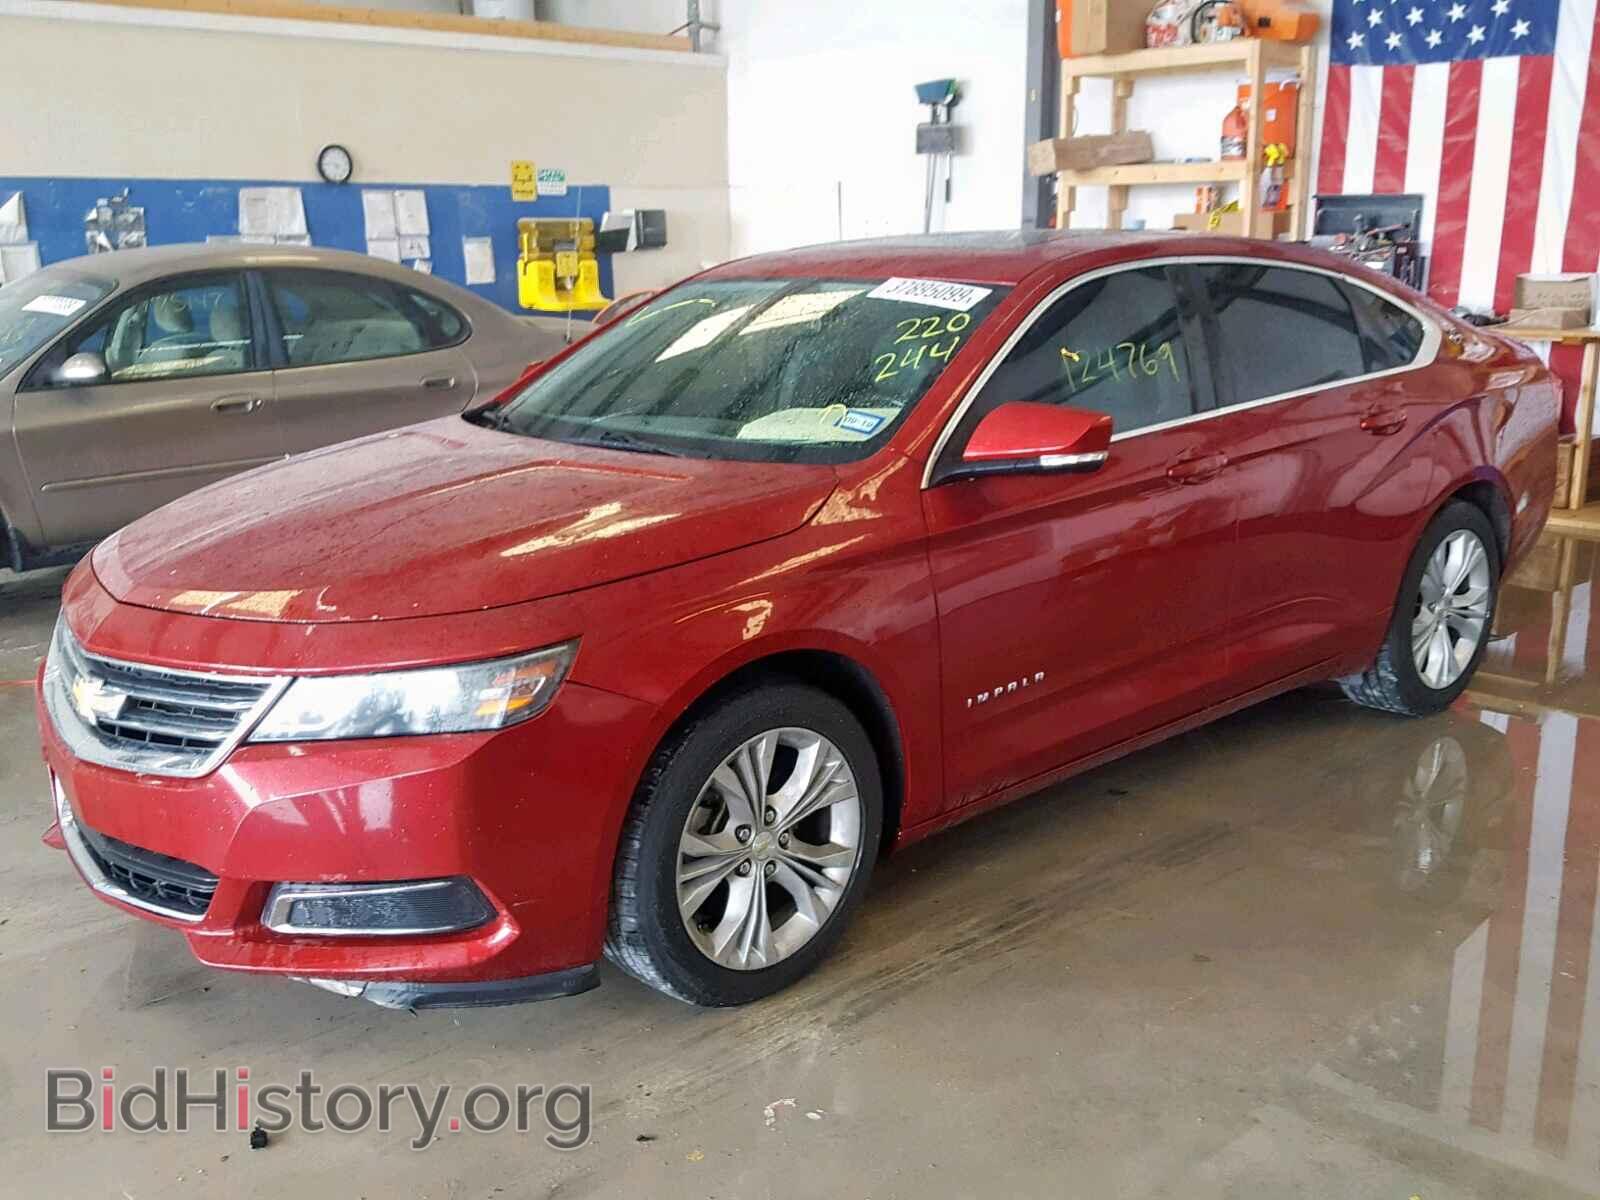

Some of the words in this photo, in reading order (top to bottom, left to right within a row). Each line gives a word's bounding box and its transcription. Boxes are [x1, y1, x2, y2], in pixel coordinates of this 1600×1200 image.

[893, 312, 971, 345] 220
[874, 335, 961, 383] 244
[966, 671, 1045, 708] IMPALA
